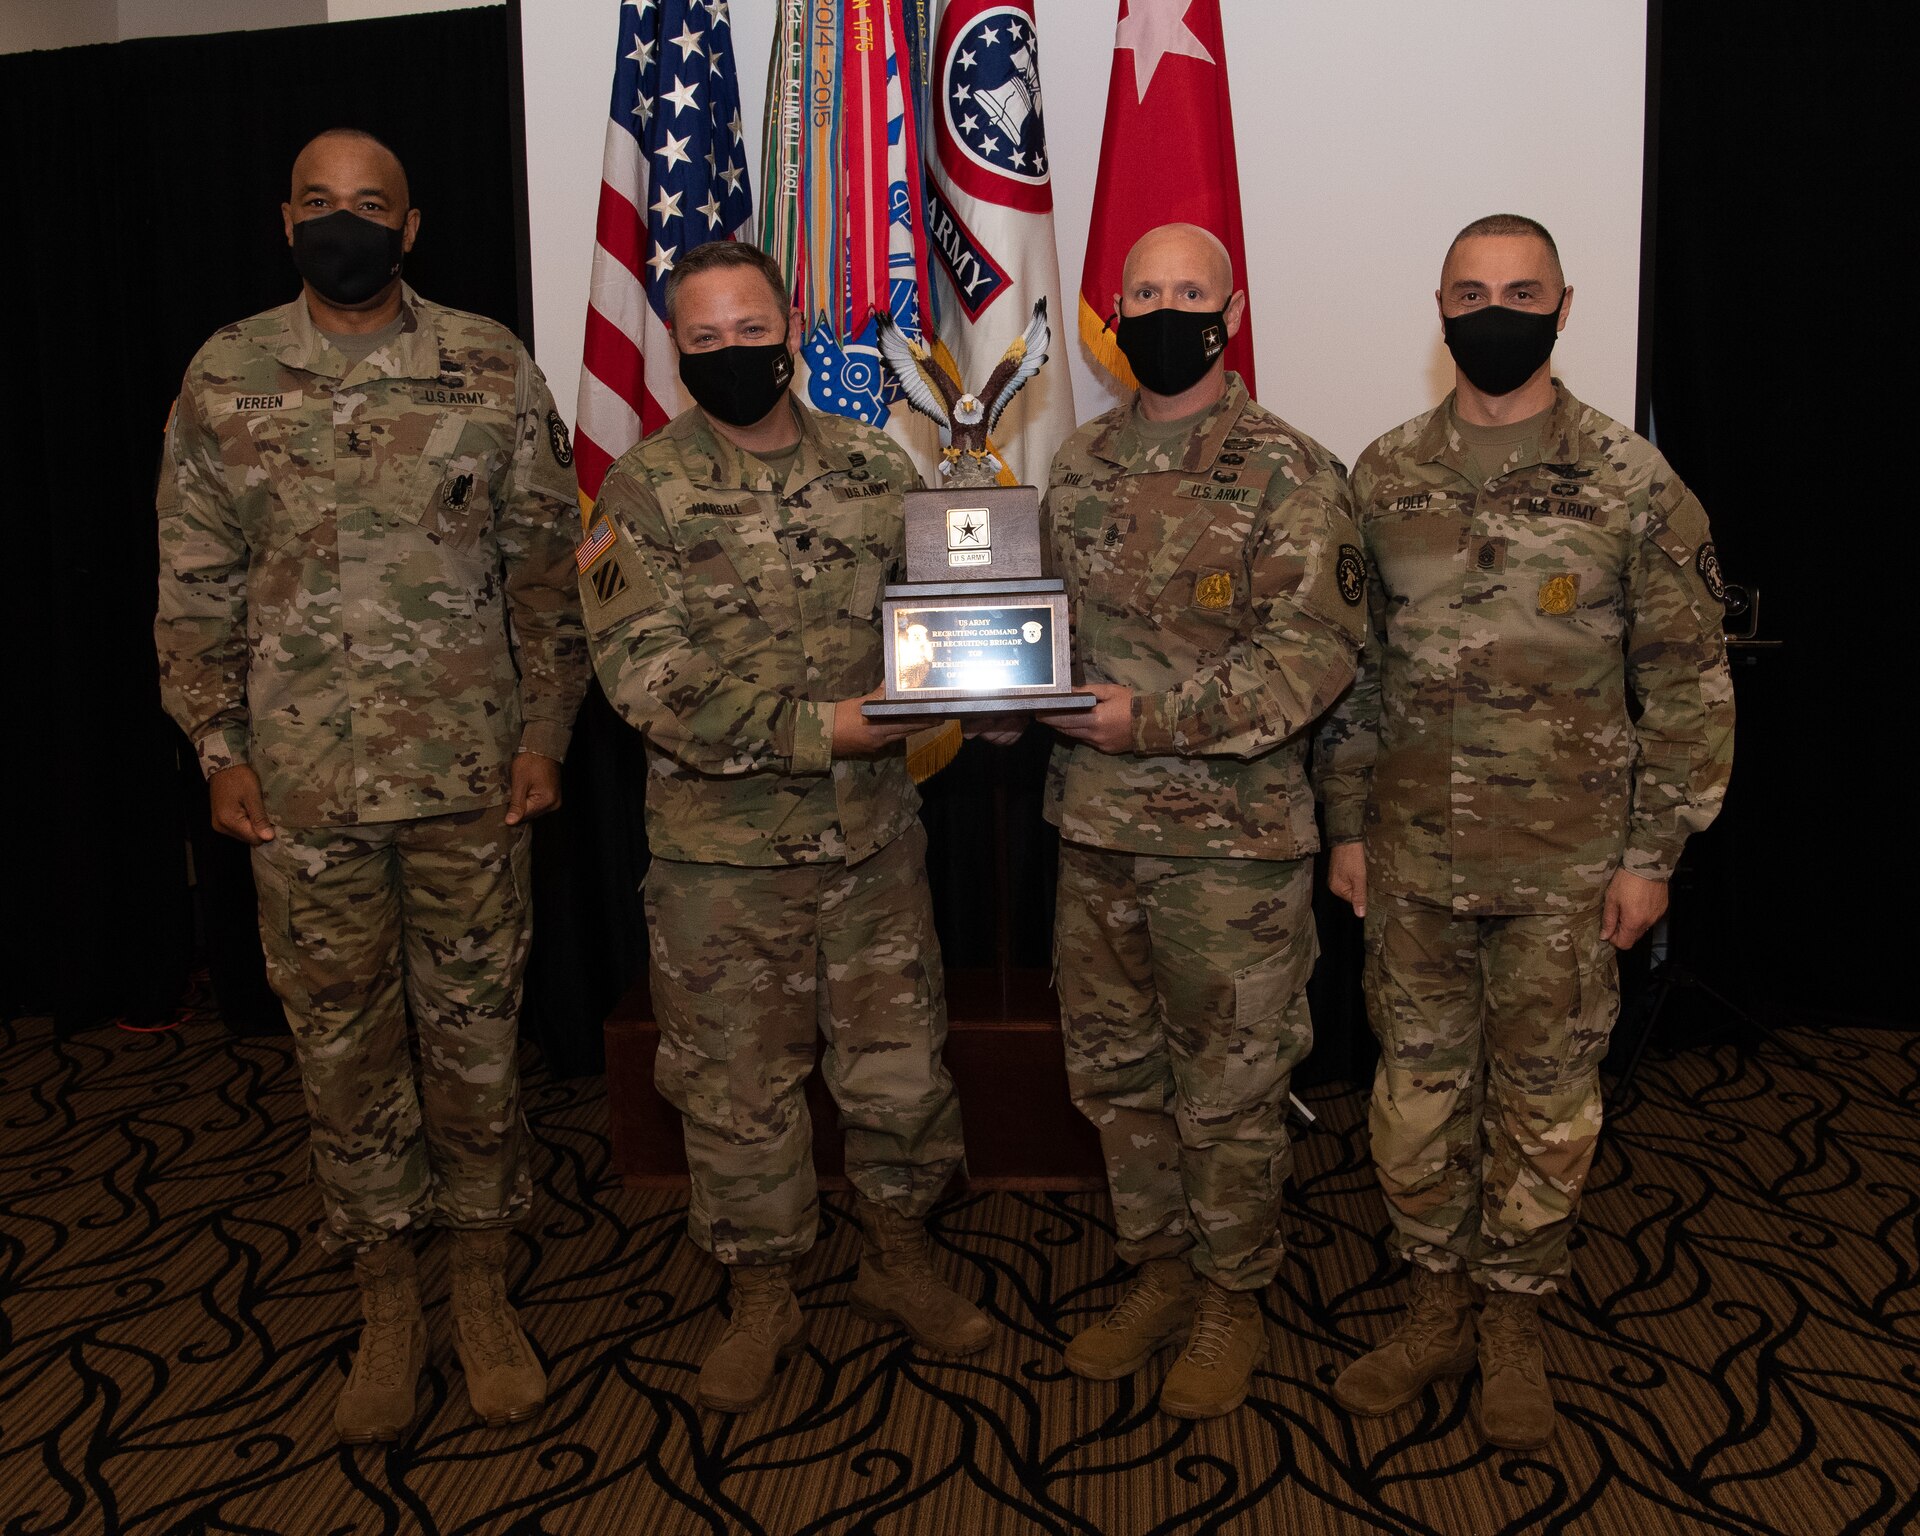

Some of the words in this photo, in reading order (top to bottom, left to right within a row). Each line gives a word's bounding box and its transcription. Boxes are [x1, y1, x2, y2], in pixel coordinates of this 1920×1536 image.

[853, 17, 874, 52] 1775
[928, 197, 992, 297] ARMY
[236, 395, 283, 410] VEREEN
[1215, 487, 1250, 502] ARMY
[1396, 494, 1433, 510] FOLEY
[1556, 501, 1598, 521] ARMY
[978, 628, 1018, 636] COMMAND
